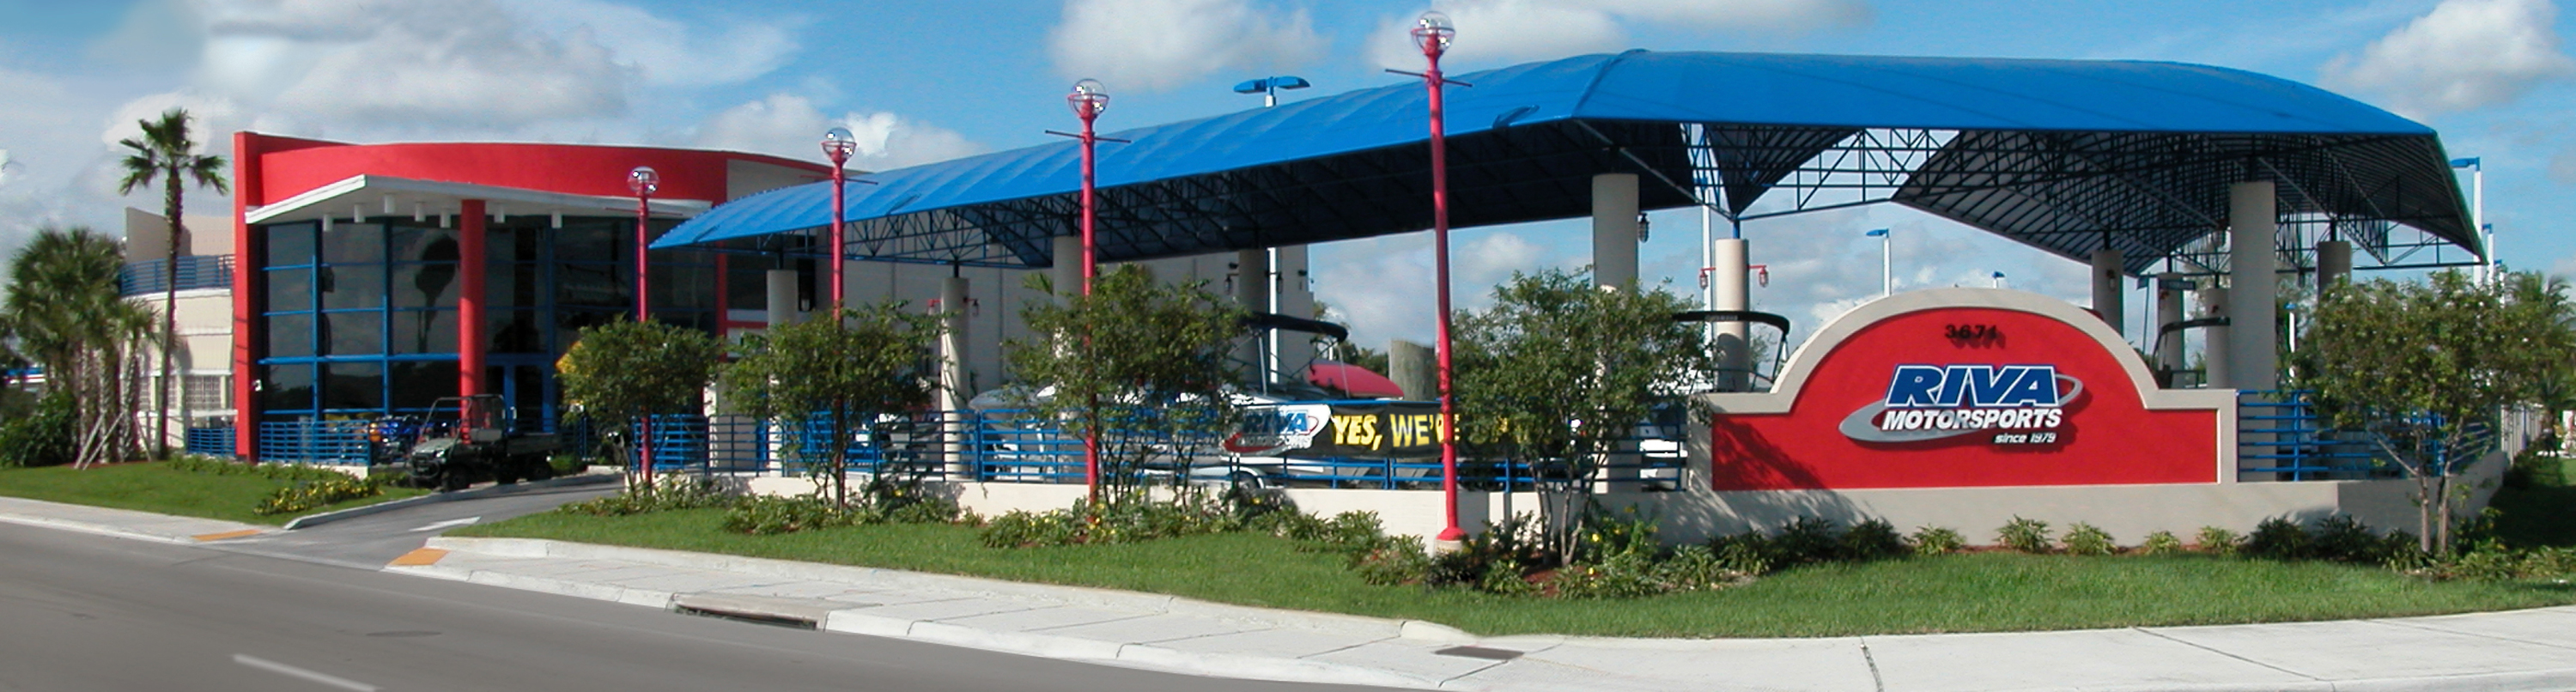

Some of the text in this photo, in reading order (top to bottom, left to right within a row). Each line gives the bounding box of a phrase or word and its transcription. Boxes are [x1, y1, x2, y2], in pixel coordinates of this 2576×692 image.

[1945, 324, 1996, 339] 3671
[1884, 364, 2060, 407] RIVA
[1881, 408, 2063, 430] MOTORSPORTS
[1333, 414, 1382, 451] YES,
[1995, 431, 2057, 444] since 1979
